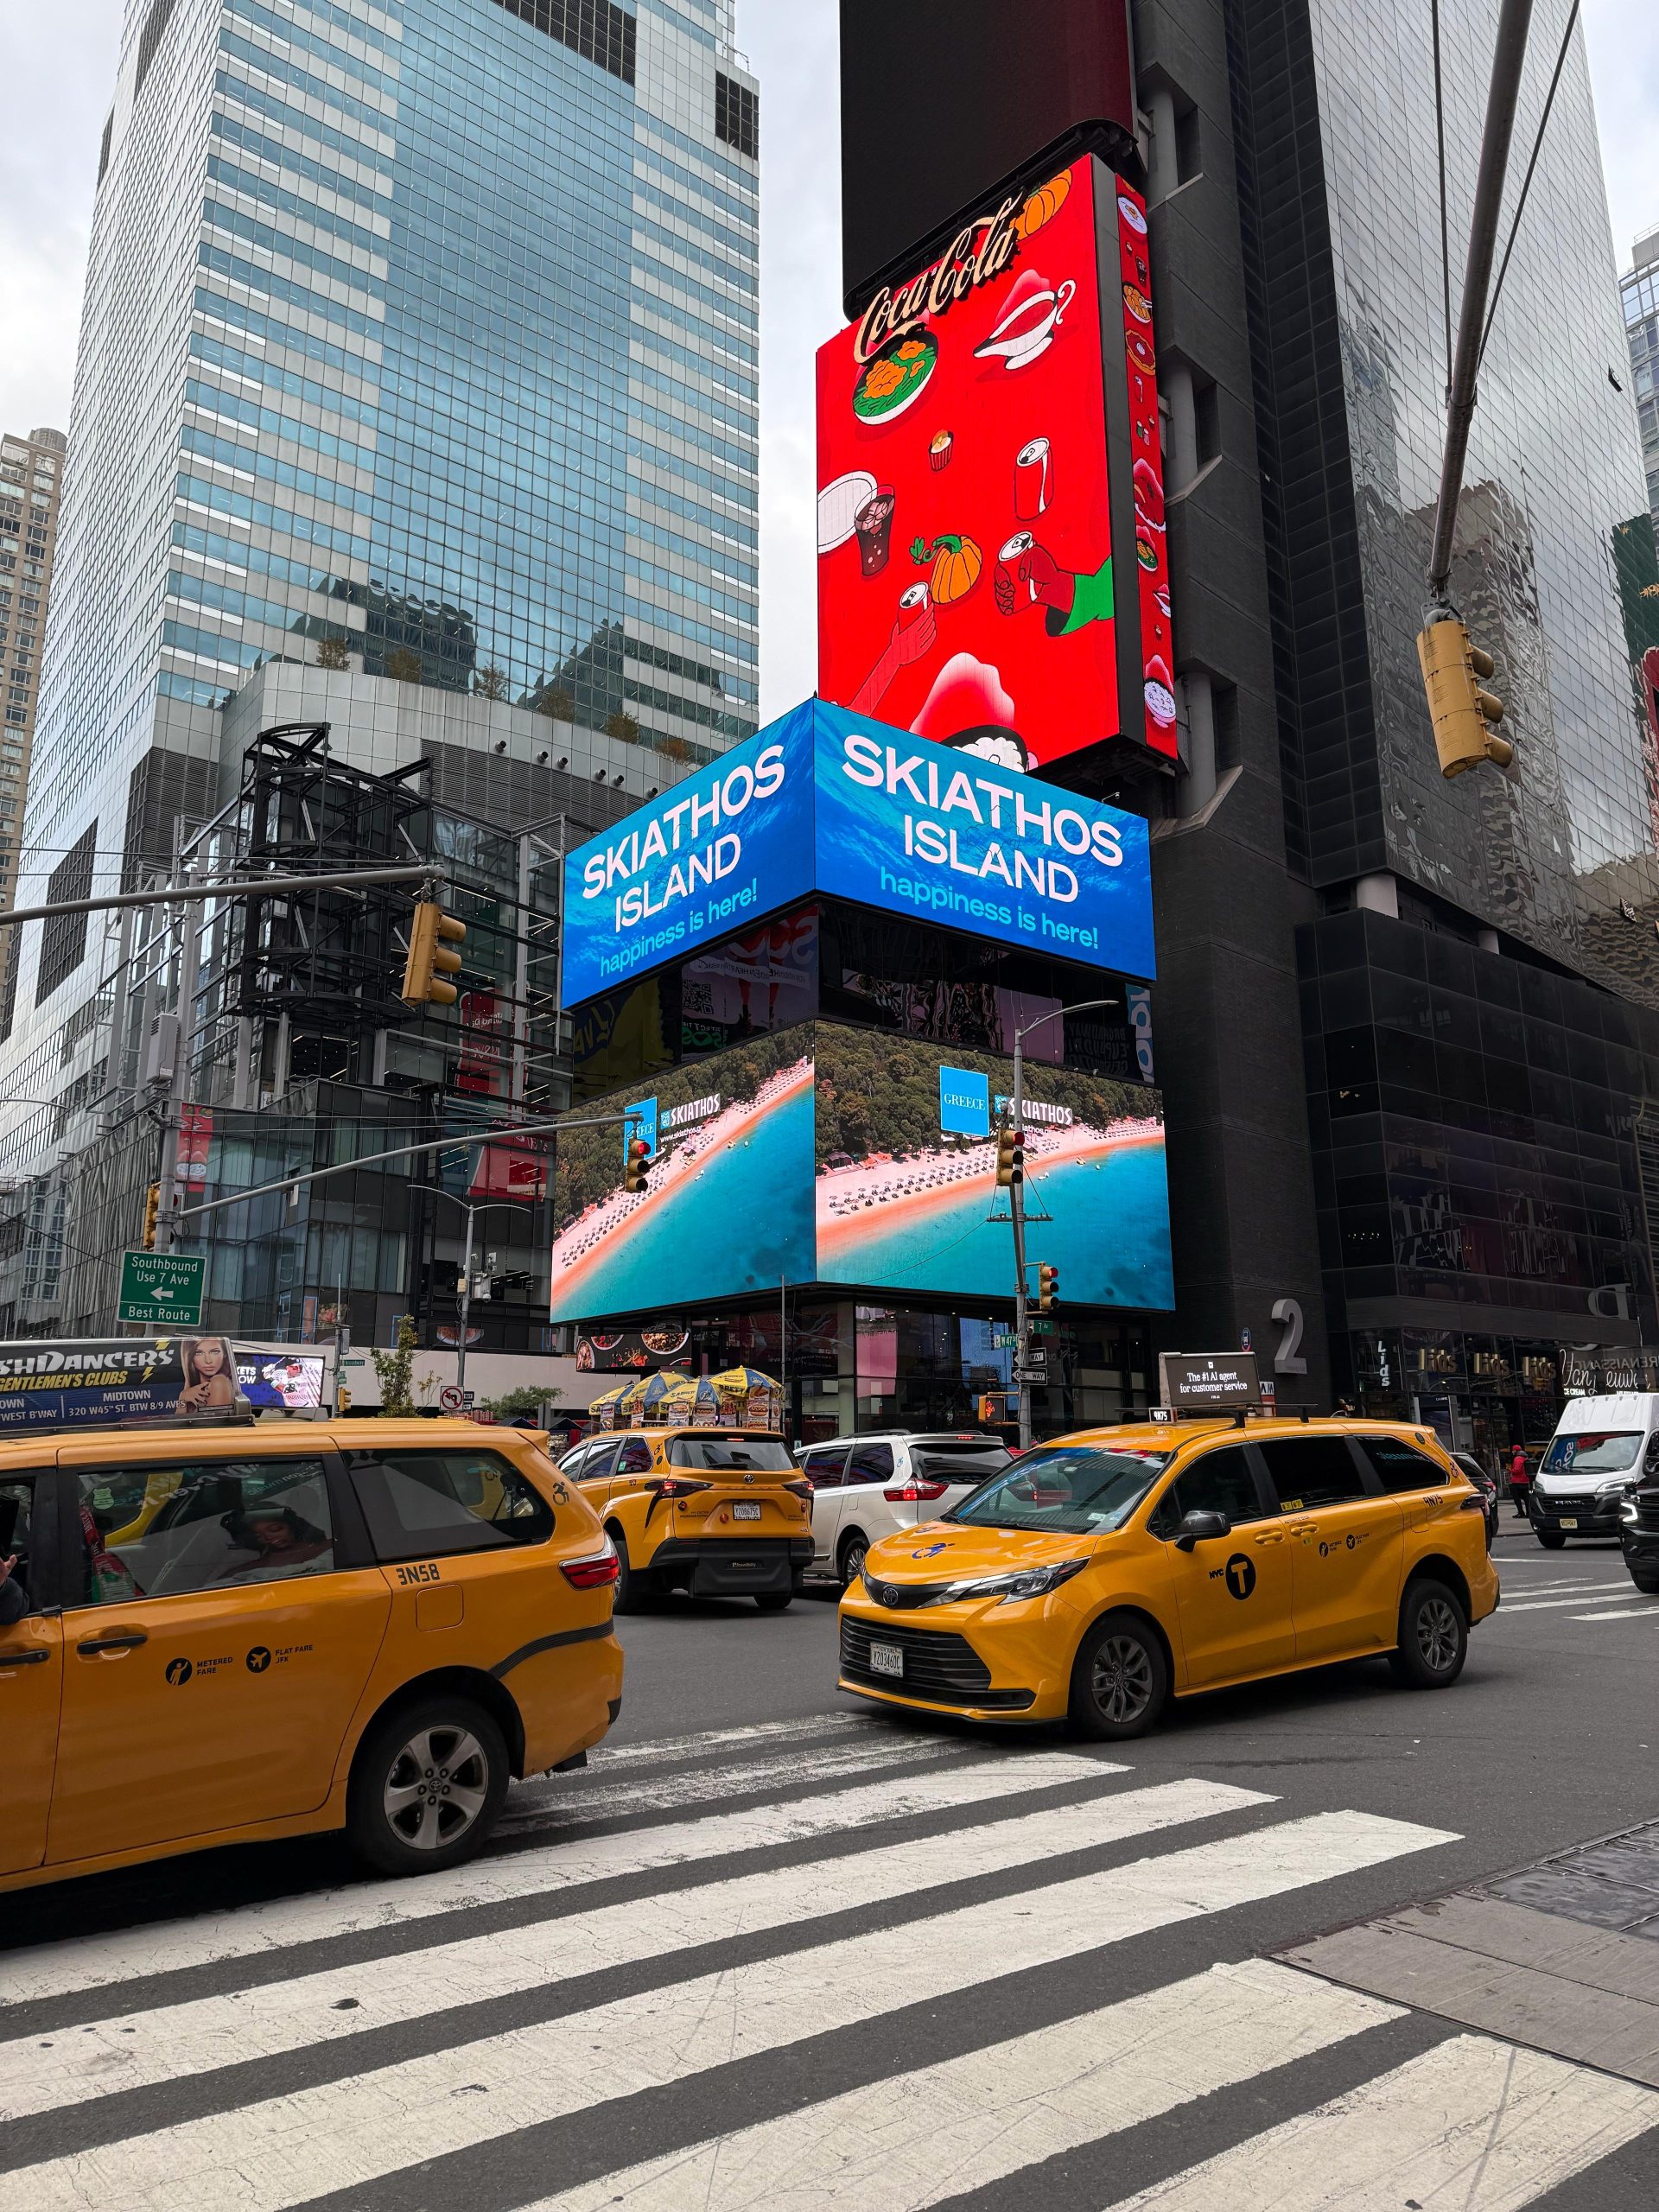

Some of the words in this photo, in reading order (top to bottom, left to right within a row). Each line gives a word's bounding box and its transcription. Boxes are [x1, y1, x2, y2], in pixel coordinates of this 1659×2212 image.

[842, 734, 1123, 868] SKIATHOS
[582, 744, 785, 899] SKIATHOS
[904, 814, 1079, 904] ISLAND
[614, 832, 741, 932] ISLAND
[880, 865, 1012, 925] happiness
[1018, 906, 1036, 931] is
[1042, 914, 1099, 950] here!
[600, 919, 685, 977] happiness
[690, 910, 704, 933] is
[708, 877, 758, 924] here!
[671, 1093, 721, 1127] SKIATHOS
[944, 1093, 986, 1110] GREECE
[131, 1256, 198, 1273] Southbound
[137, 1270, 156, 1282] Use
[160, 1272, 166, 1283] 7
[169, 1273, 189, 1286] Ave
[128, 1306, 153, 1319] Best
[158, 1307, 190, 1321] Route
[1039, 1322, 1042, 1332] 7
[1006, 1335, 1012, 1345] 47
[1271, 1298, 1307, 1375] 2
[1377, 1340, 1390, 1387] Lids
[84, 1370, 129, 1387] CLUBS
[1187, 1372, 1200, 1382] The
[1202, 1371, 1210, 1382] #1
[1211, 1371, 1217, 1381] AI
[1219, 1371, 1236, 1382] agent
[103, 1389, 151, 1402] MIDTOWN
[1179, 1383, 1192, 1394] for
[1192, 1382, 1224, 1393] customer
[1224, 1381, 1248, 1391] service
[1, 1411, 27, 1422] WEST
[29, 1409, 57, 1419] B'WAY
[68, 1408, 86, 1417] 320
[150, 1401, 164, 1410] 8/9
[165, 1399, 186, 1409] AVES
[1423, 1495, 1443, 1509] 9N75
[397, 1562, 441, 1586] 3N58
[1209, 1568, 1224, 1580] NYC
[1231, 1561, 1248, 1594] T
[276, 1647, 294, 1656] FLAT
[295, 1644, 314, 1653] FARE
[197, 1656, 233, 1669] METERED
[276, 1656, 289, 1664] JFK
[197, 1667, 217, 1675] FARE
